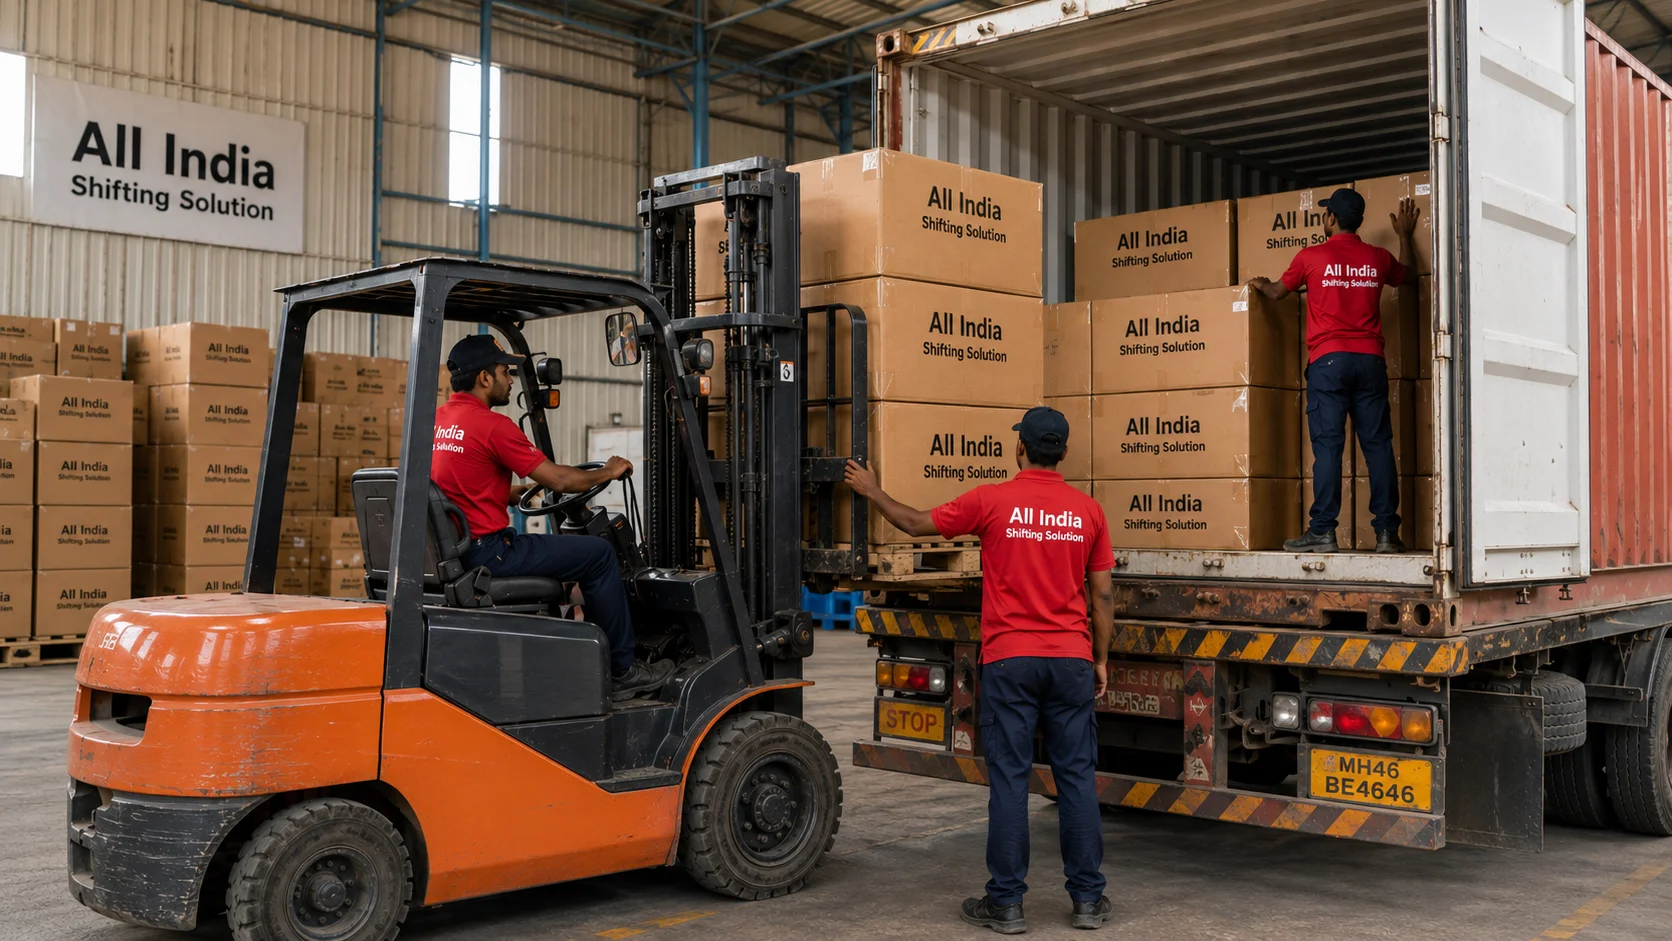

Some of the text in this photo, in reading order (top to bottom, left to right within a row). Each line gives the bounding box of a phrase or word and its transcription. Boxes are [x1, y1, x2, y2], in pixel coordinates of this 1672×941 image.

[71, 121, 275, 190] All India
[71, 175, 273, 221] Shifting Solution
[927, 186, 1002, 221] All India
[922, 216, 1006, 243] Shifting Solution
[1272, 211, 1297, 231] All
[1117, 226, 1188, 251] All India
[1266, 236, 1307, 248] Shifting
[1112, 251, 1193, 268] Shifting Solution
[1324, 264, 1377, 277] All India
[929, 311, 1002, 341] All India
[1125, 315, 1200, 338] All India
[73, 344, 85, 353] All
[208, 343, 249, 355] All India
[923, 342, 1007, 362] Shifting Solution
[1119, 340, 1205, 356] Shifting Solution
[61, 397, 109, 410] All India
[207, 405, 248, 416] All India
[436, 425, 464, 440] India
[1126, 415, 1200, 435] All India
[930, 433, 1003, 457] All India
[1120, 441, 1206, 455] Shifting Solution
[61, 461, 108, 472] All India
[207, 464, 248, 475] All India
[924, 465, 1007, 482] Shifting Solution
[1129, 494, 1202, 512] All India
[1009, 507, 1082, 529] All India
[1124, 519, 1207, 532] Shifting Solution
[61, 525, 108, 535] All India
[205, 525, 247, 534] All India
[1006, 528, 1084, 543] Shifting Solution
[60, 589, 107, 599] All India
[205, 581, 219, 591] All
[886, 709, 938, 733] STOP
[1339, 756, 1399, 779] MH46
[1325, 776, 1415, 803] BE4646
